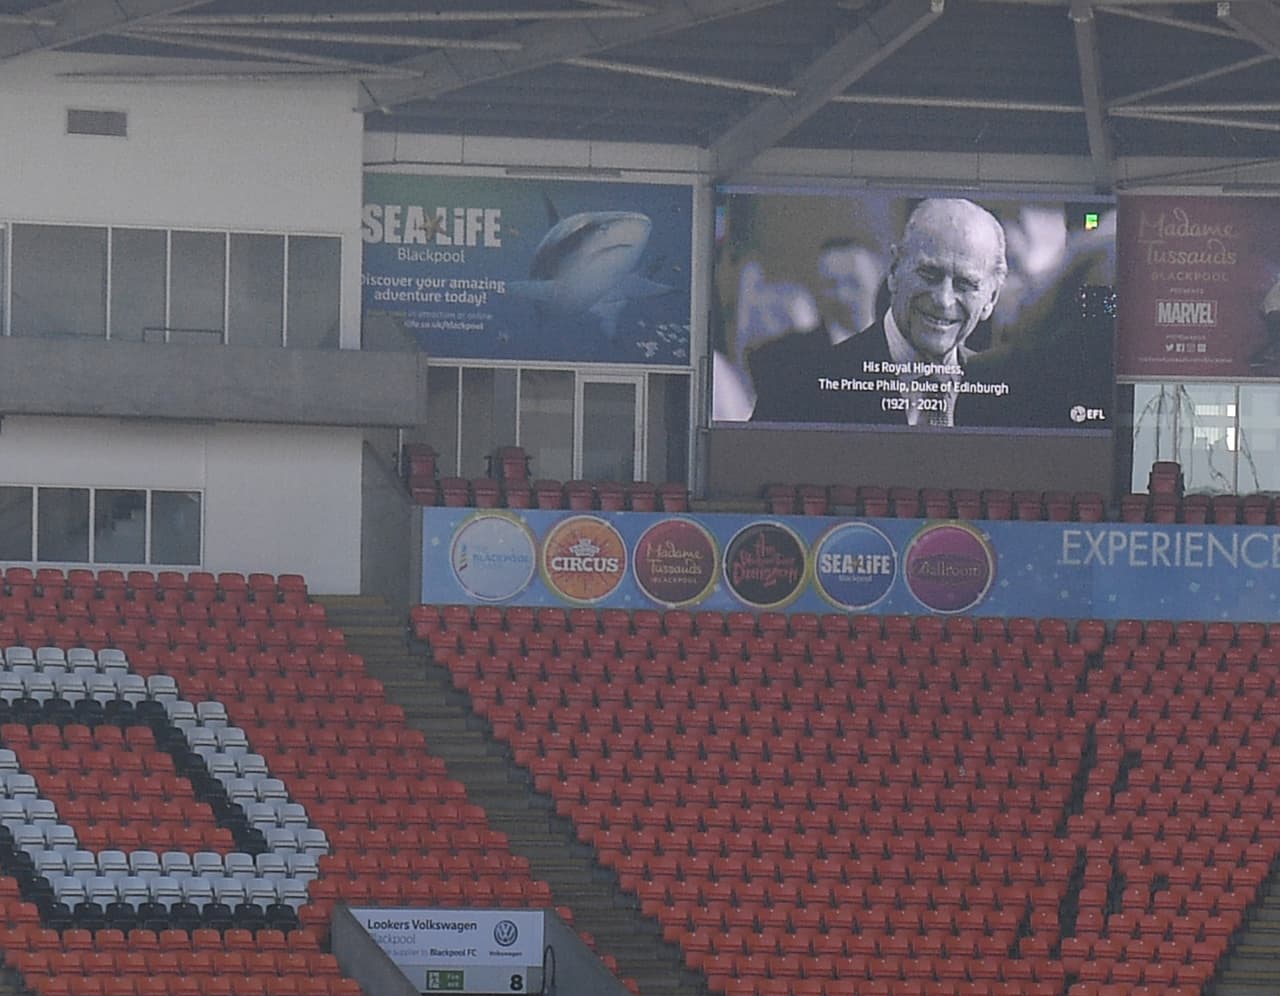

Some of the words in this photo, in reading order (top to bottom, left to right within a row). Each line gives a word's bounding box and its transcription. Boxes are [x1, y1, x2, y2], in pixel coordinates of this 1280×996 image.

[362, 203, 426, 246] SEA
[1138, 207, 1240, 239] Madame
[398, 248, 465, 264] Blackpool
[1138, 238, 1237, 265] Tussauds
[1151, 271, 1230, 281] BLACKPOOL
[416, 278, 445, 290] your
[449, 277, 506, 294] amazing
[374, 288, 442, 302] adventure
[445, 291, 487, 307] today!
[1158, 303, 1215, 323] MARVEL
[863, 361, 880, 373] His
[882, 362, 912, 376] Royal
[913, 362, 964, 377] Highness,
[819, 378, 839, 391] The
[841, 378, 874, 392] Prince
[876, 379, 909, 394] Philip,
[911, 380, 938, 392] Duke
[940, 380, 952, 392] of
[954, 381, 1009, 396] Edinburgh
[1087, 408, 1105, 420] EFL
[647, 541, 703, 560] Madame
[551, 556, 619, 573] CIRCUS
[649, 555, 702, 575] Tussauds
[821, 554, 853, 573] SEA
[367, 919, 410, 930] Lookers
[412, 919, 477, 933] Volkswagen
[430, 948, 466, 957] Blackpool
[467, 948, 477, 957] FC
[510, 974, 523, 991] 8
